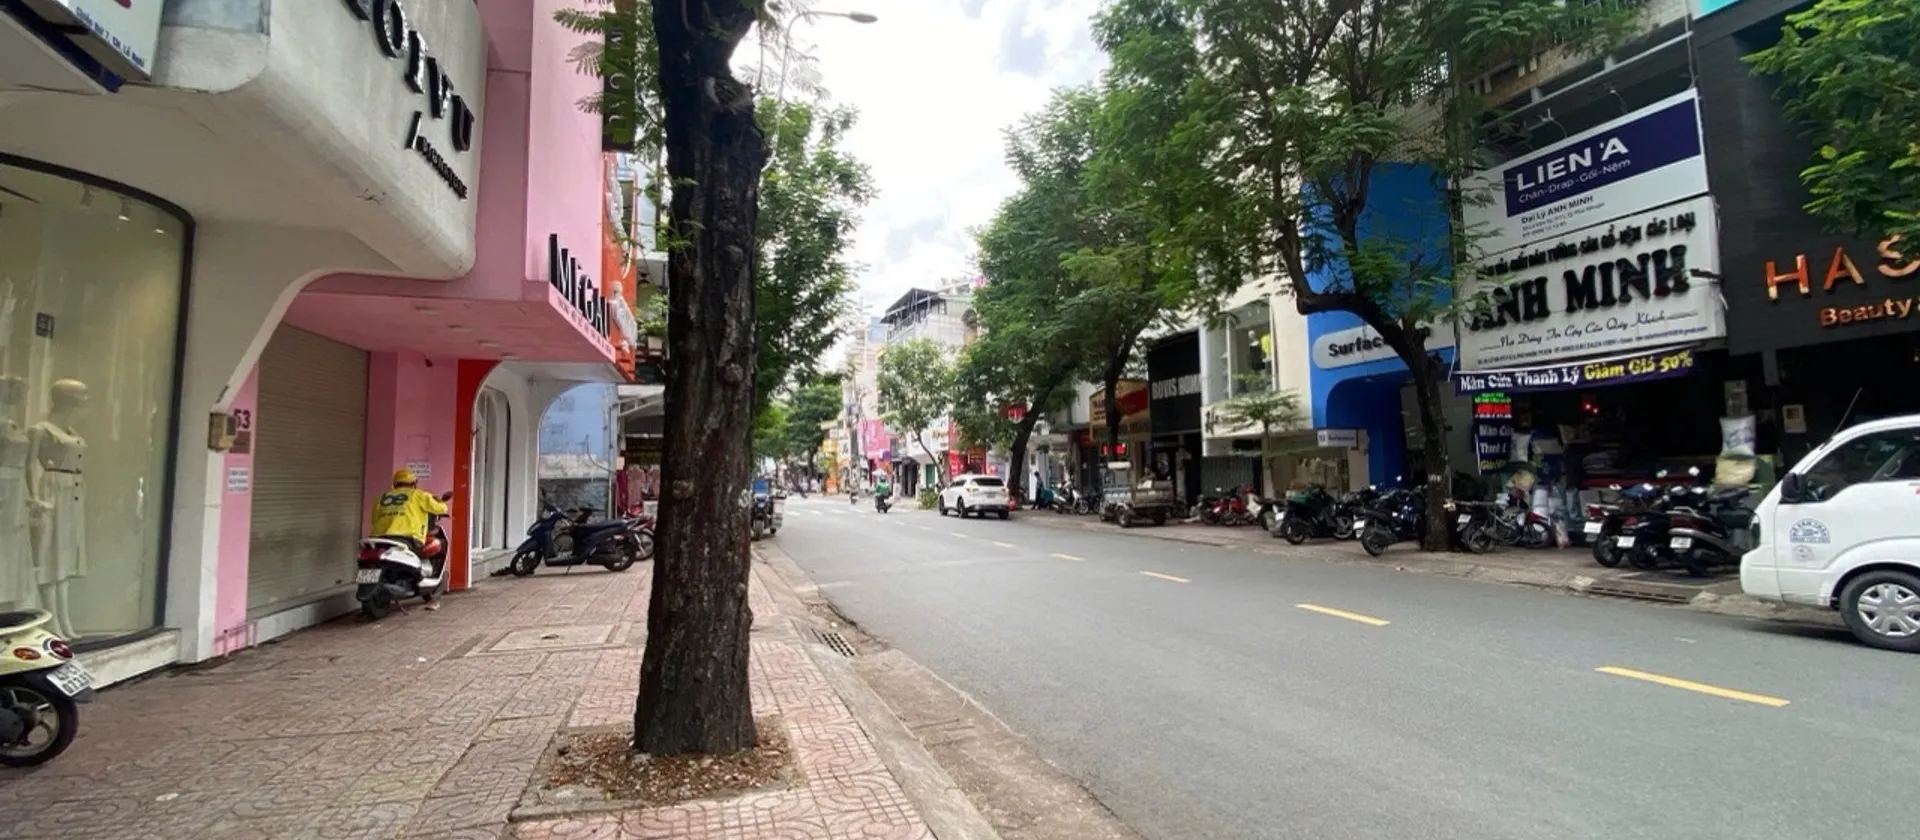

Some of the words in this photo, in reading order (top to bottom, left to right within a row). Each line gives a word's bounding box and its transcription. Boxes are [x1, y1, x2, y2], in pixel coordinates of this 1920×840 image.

[1548, 204, 1567, 217] ANH
[1569, 195, 1594, 209] MINH
[1563, 244, 1691, 314] MINH
[1821, 298, 1912, 327] Beauty
[1328, 336, 1384, 357] Surfac
[1461, 376, 1485, 391] Màn
[1515, 370, 1558, 385] Thanh
[1584, 362, 1625, 380] Giảm
[1628, 356, 1656, 375] Giá
[1660, 349, 1694, 373] 50%
[379, 492, 408, 507] be
